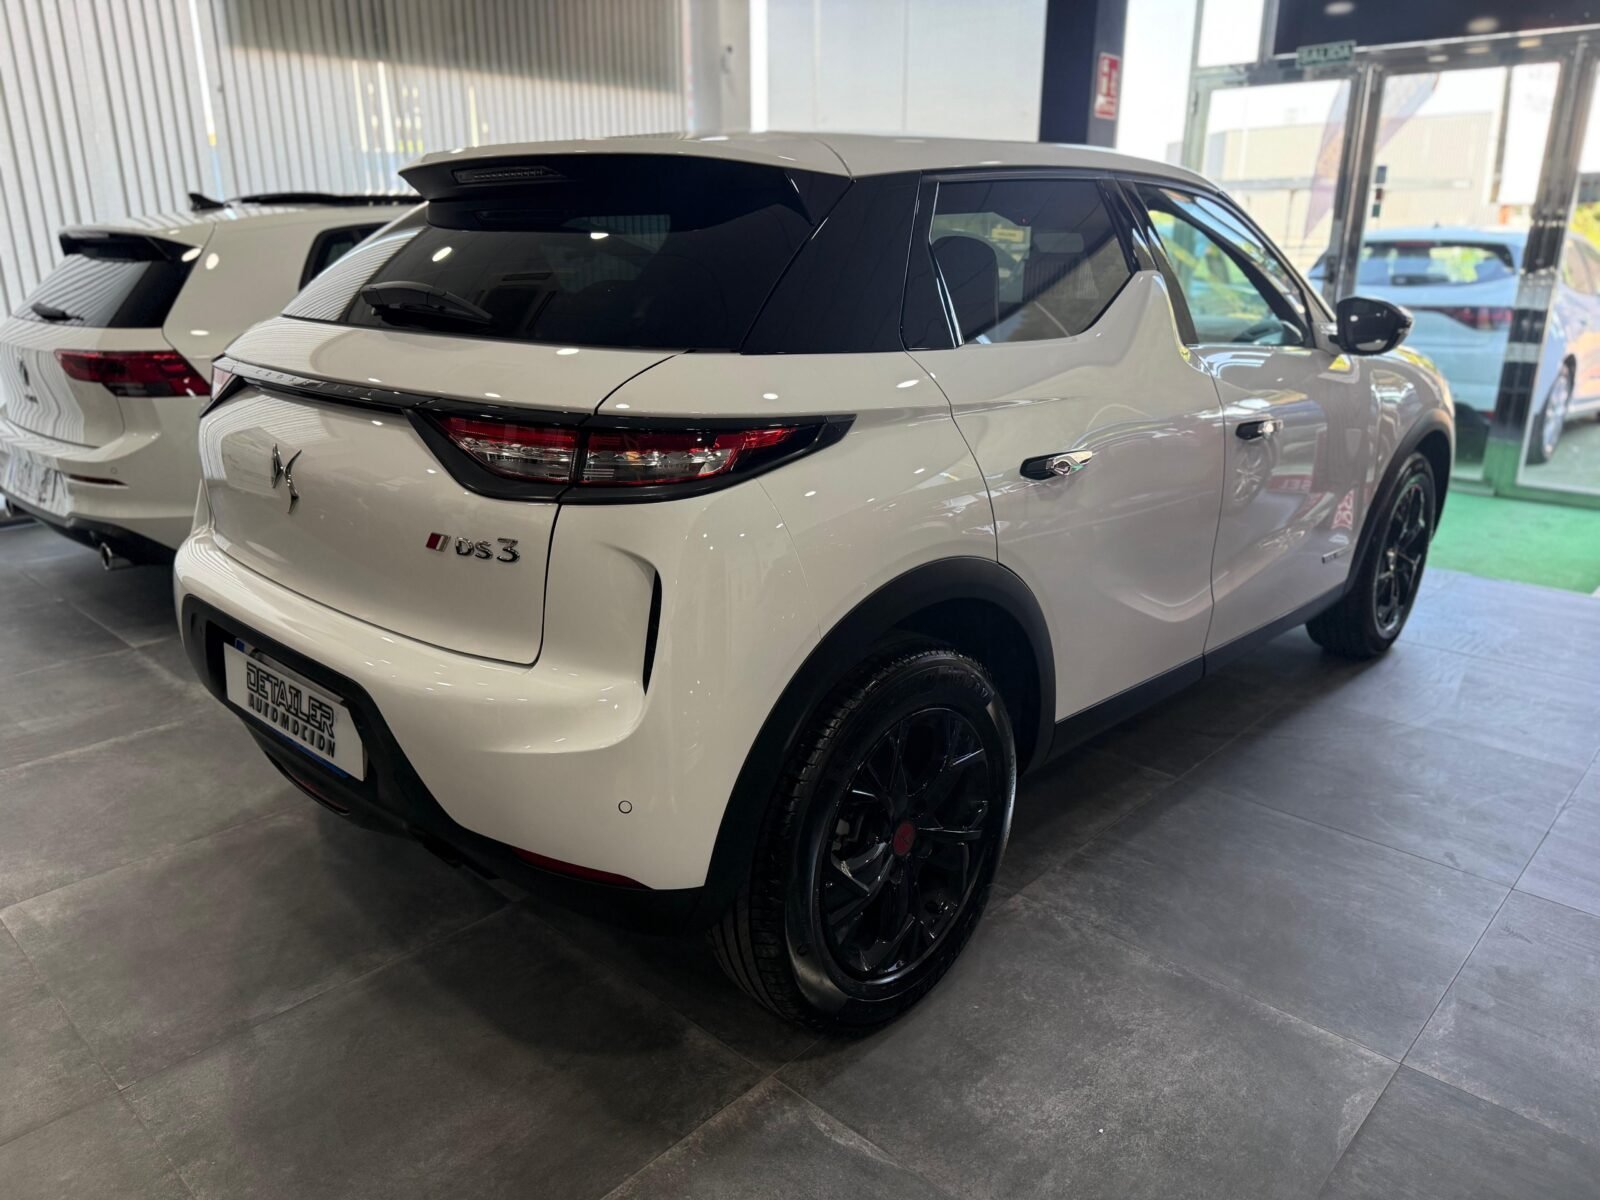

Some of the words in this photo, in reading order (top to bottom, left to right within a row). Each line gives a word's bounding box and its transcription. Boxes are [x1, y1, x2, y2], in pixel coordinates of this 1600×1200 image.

[455, 537, 493, 559] DS
[496, 537, 520, 562] 3
[246, 662, 335, 738] DETAILER
